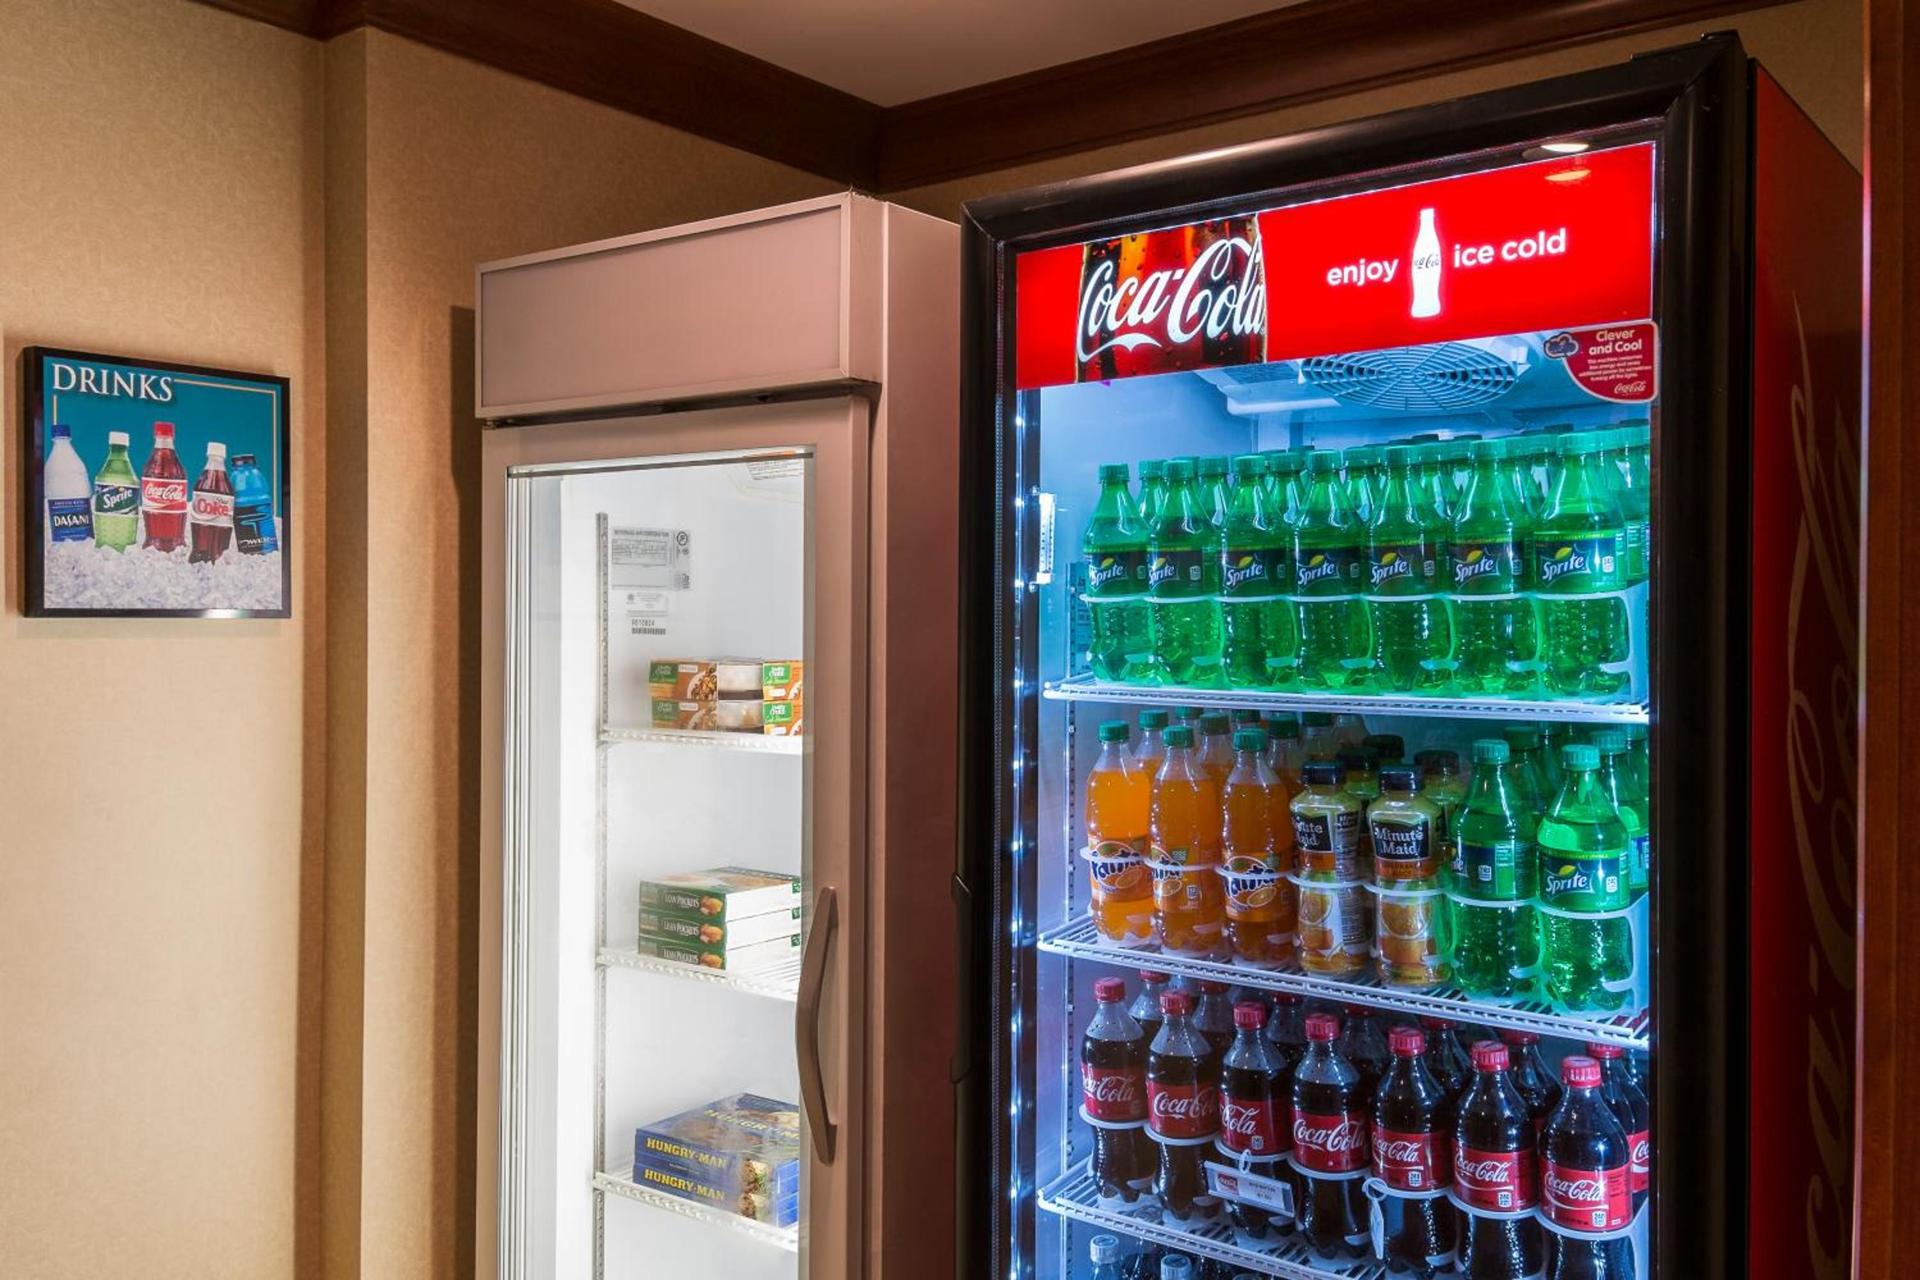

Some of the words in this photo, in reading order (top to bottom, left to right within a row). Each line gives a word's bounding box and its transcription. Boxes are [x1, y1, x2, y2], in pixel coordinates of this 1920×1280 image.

[1453, 244, 1494, 268] ice
[1501, 228, 1567, 261] cold
[1327, 258, 1399, 286] enjoy
[1077, 235, 1266, 362] Coca-Cola
[1589, 342, 1613, 356] and
[1615, 339, 1642, 352] Cool
[1596, 329, 1635, 342] Clever
[52, 363, 173, 402] DRINKS
[103, 487, 134, 509] Sprite
[197, 497, 230, 517] Coke
[53, 514, 90, 528] DASANI
[1226, 560, 1264, 586] Sprite
[1298, 558, 1336, 586] Sprite
[1370, 558, 1409, 584] Sprite
[1454, 556, 1495, 583] Sprite
[1542, 552, 1585, 581] Sprite
[1374, 826, 1424, 842] Minute
[1381, 840, 1419, 856] Maid
[1545, 871, 1588, 895] Sprite
[1293, 1119, 1363, 1152] Coca-Cola
